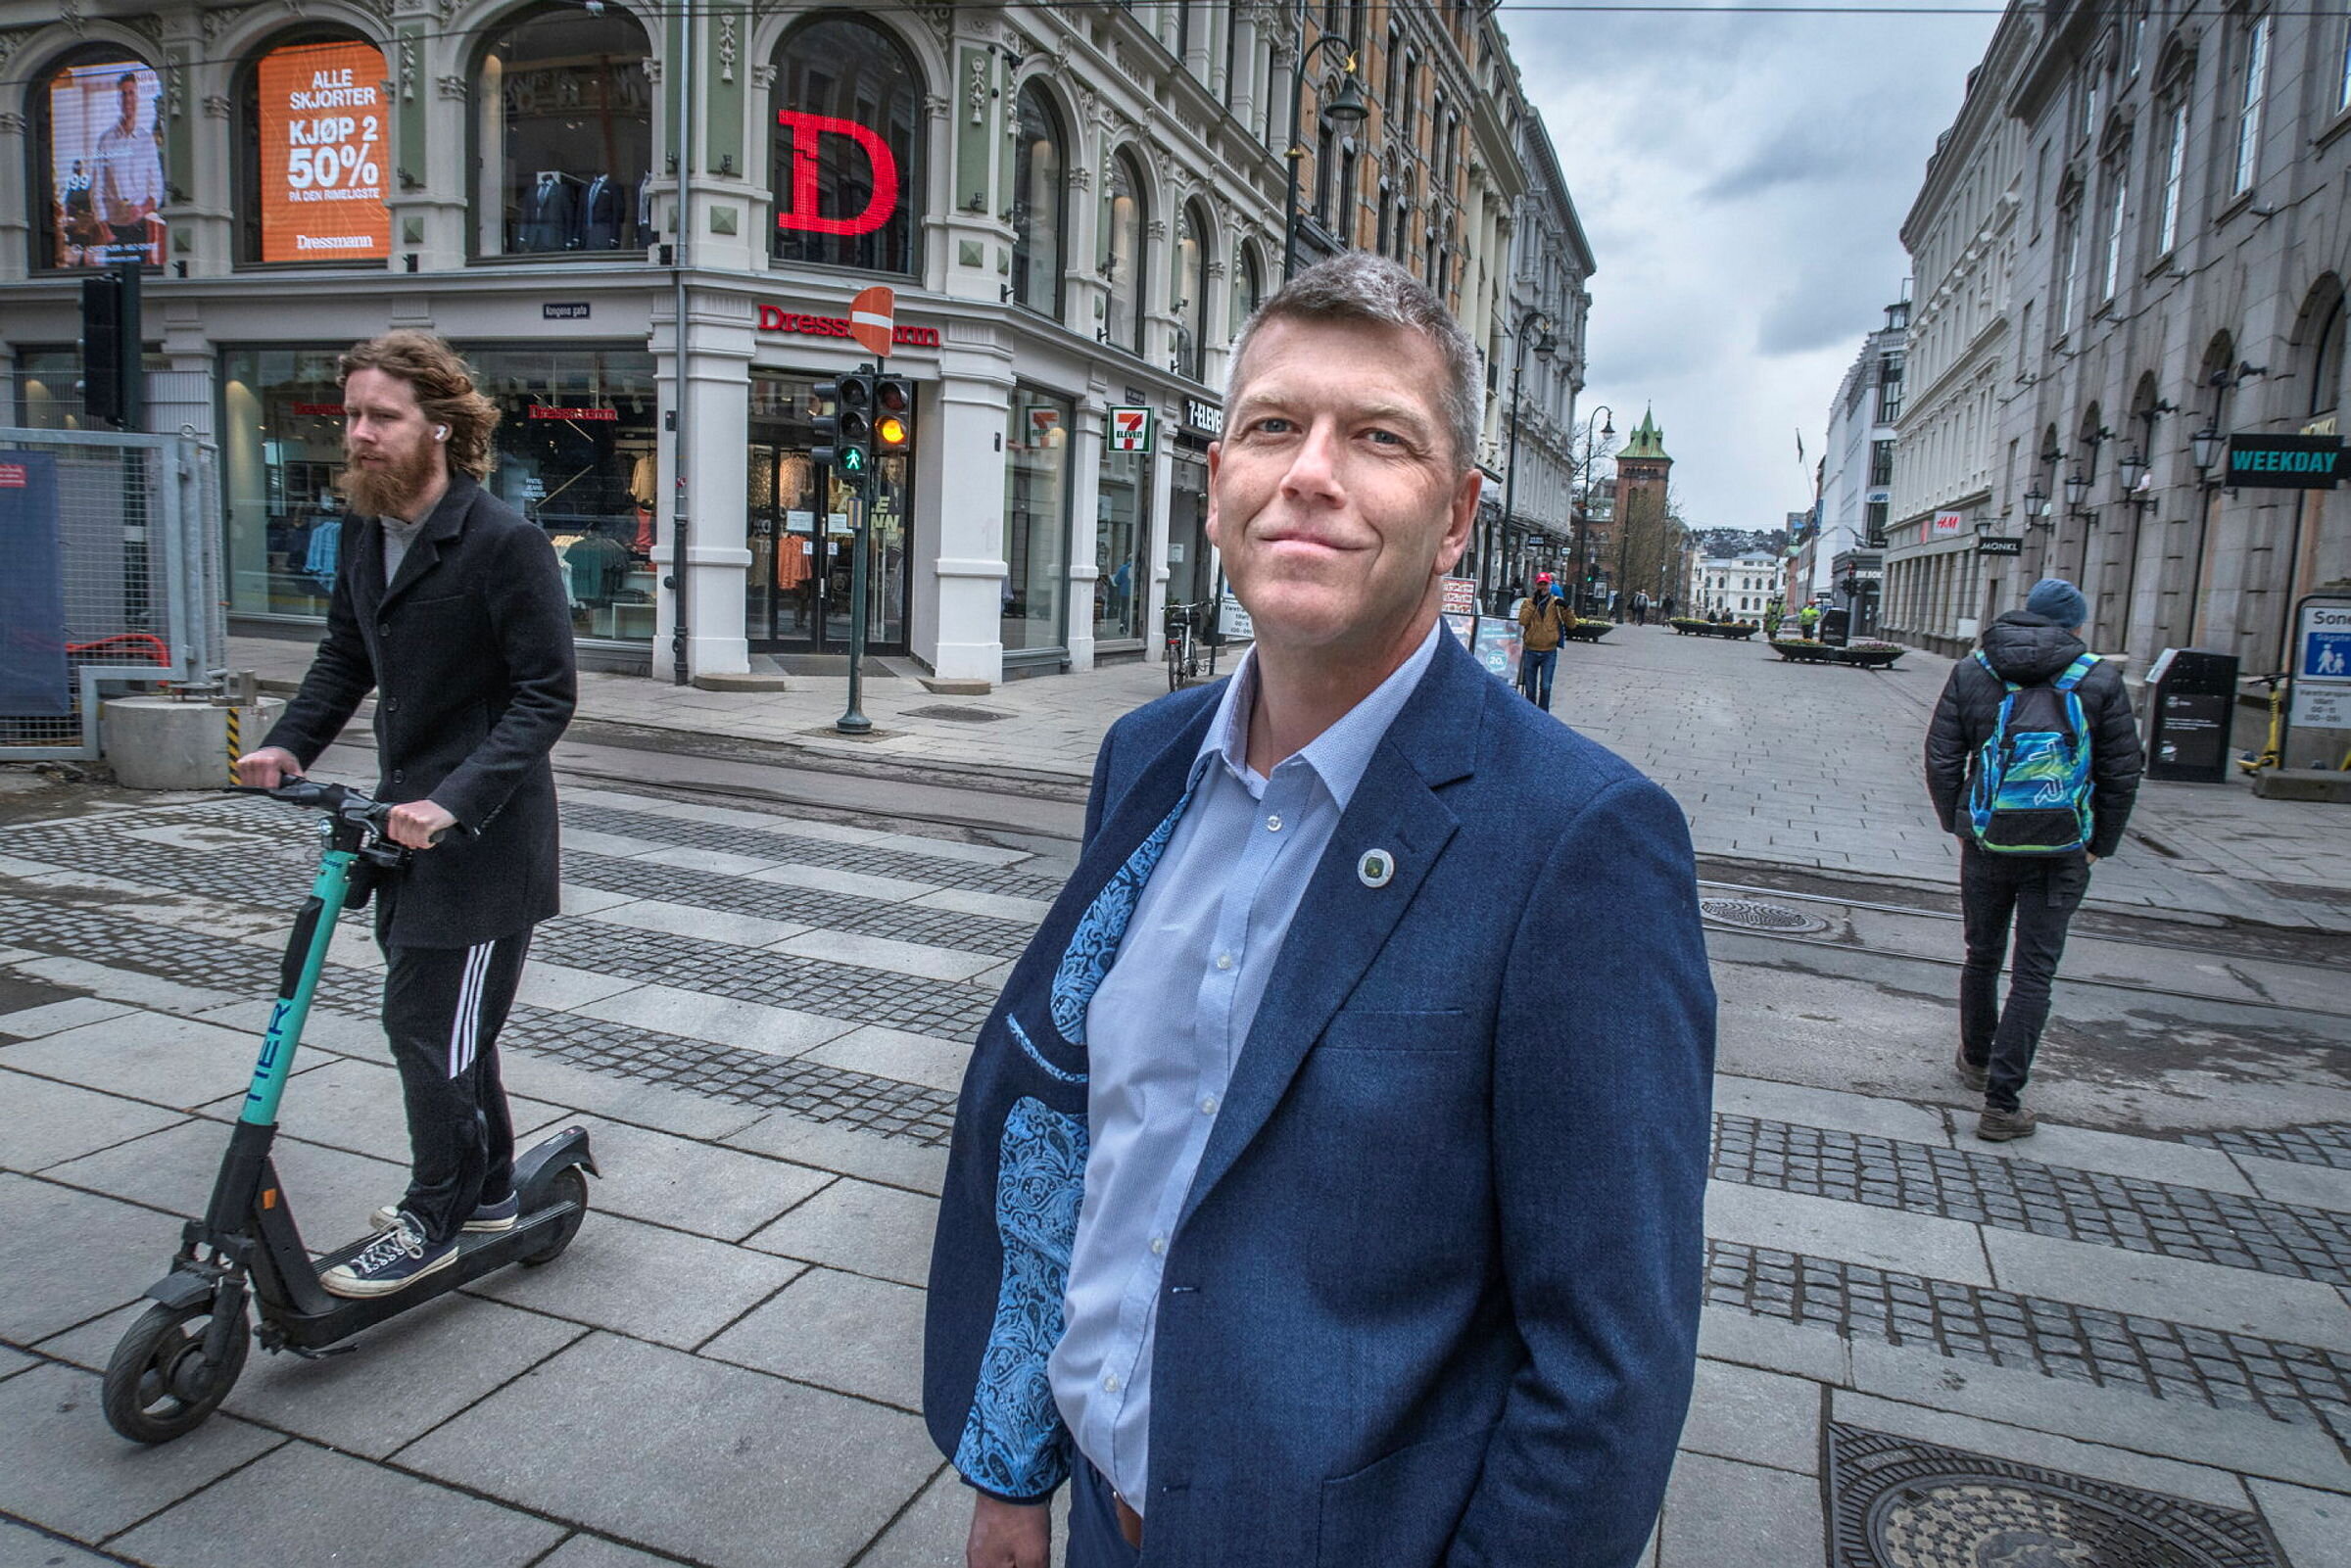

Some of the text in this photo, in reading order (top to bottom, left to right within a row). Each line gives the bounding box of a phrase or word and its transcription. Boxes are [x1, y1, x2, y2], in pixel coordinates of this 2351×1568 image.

[312, 68, 354, 89] ALLE
[289, 86, 376, 110] SKJORTER
[289, 115, 378, 146] KJØP 2
[287, 142, 379, 188] 50%
[778, 109, 899, 236] D
[303, 189, 323, 202] DEN
[324, 187, 380, 201] RIMELIGSTE
[296, 234, 373, 250] Dressmann
[758, 305, 940, 348] Dressann
[528, 404, 618, 421] Dressmann
[1188, 400, 1223, 434] 7-ELEVE
[2232, 451, 2338, 473] WEEKDAY
